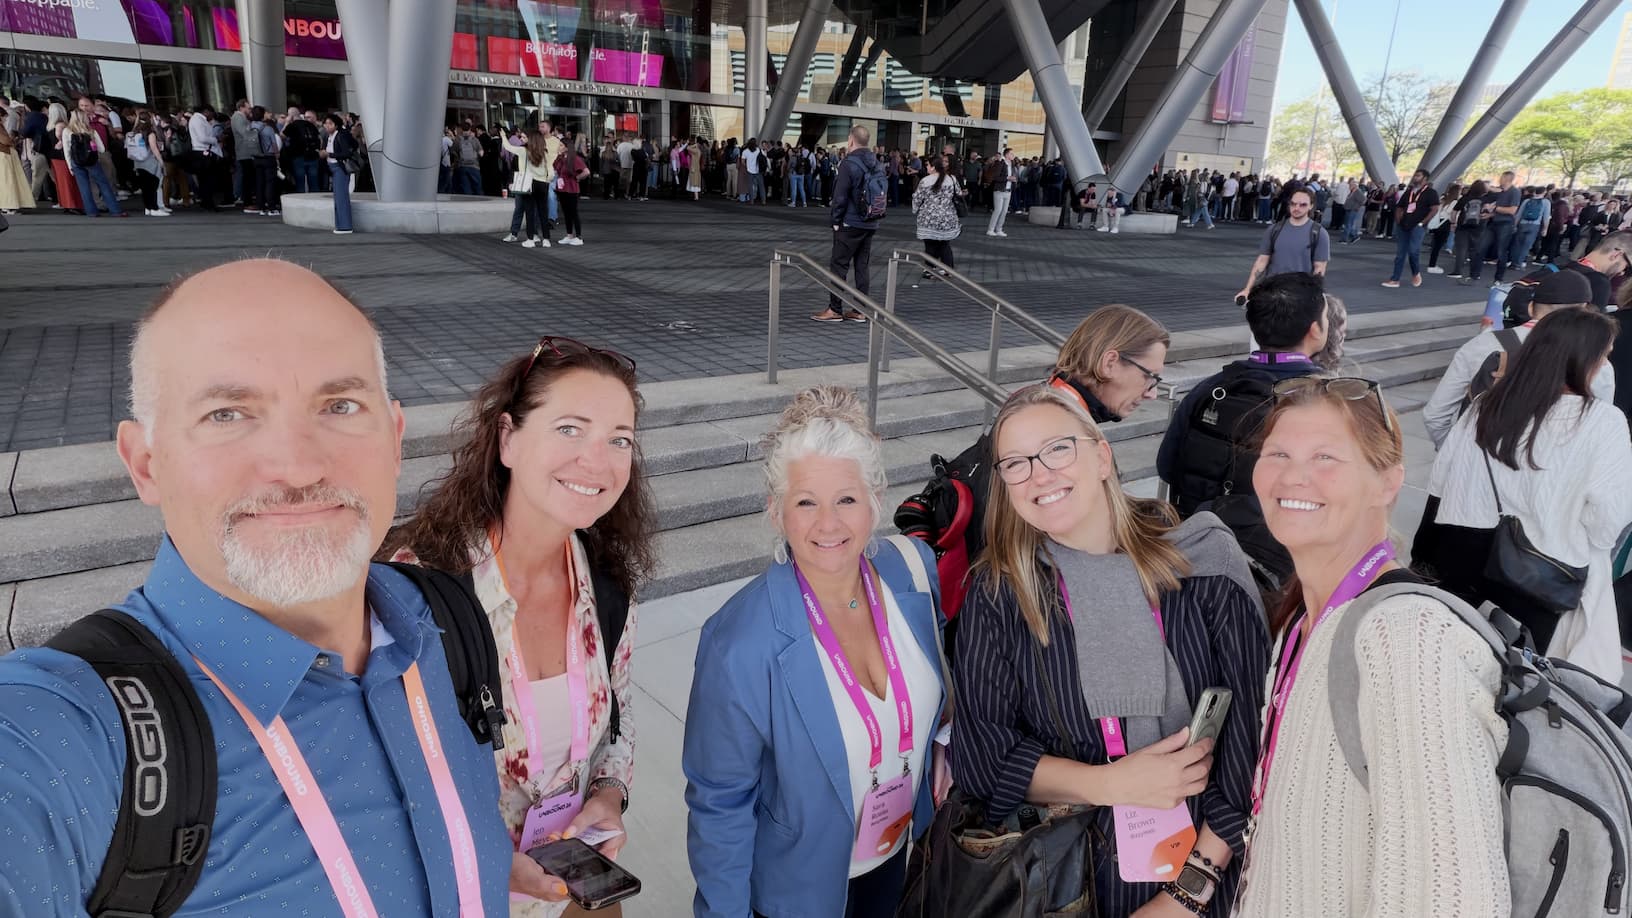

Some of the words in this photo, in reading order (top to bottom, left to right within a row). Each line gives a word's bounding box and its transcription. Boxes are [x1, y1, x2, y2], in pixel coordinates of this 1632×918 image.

[284, 18, 342, 40] NBOU
[1358, 548, 1387, 577] UNBOUND
[803, 593, 823, 625] UNBOUND
[834, 653, 853, 687] UNBOUND
[883, 636, 897, 670] UNBOUND
[415, 695, 438, 758] UNBOUND
[106, 676, 167, 817] OGIO
[266, 726, 308, 796] UNBOUND
[1125, 810, 1137, 819] Liz
[1128, 817, 1155, 831] Brown
[336, 857, 369, 918] UNBOUN
